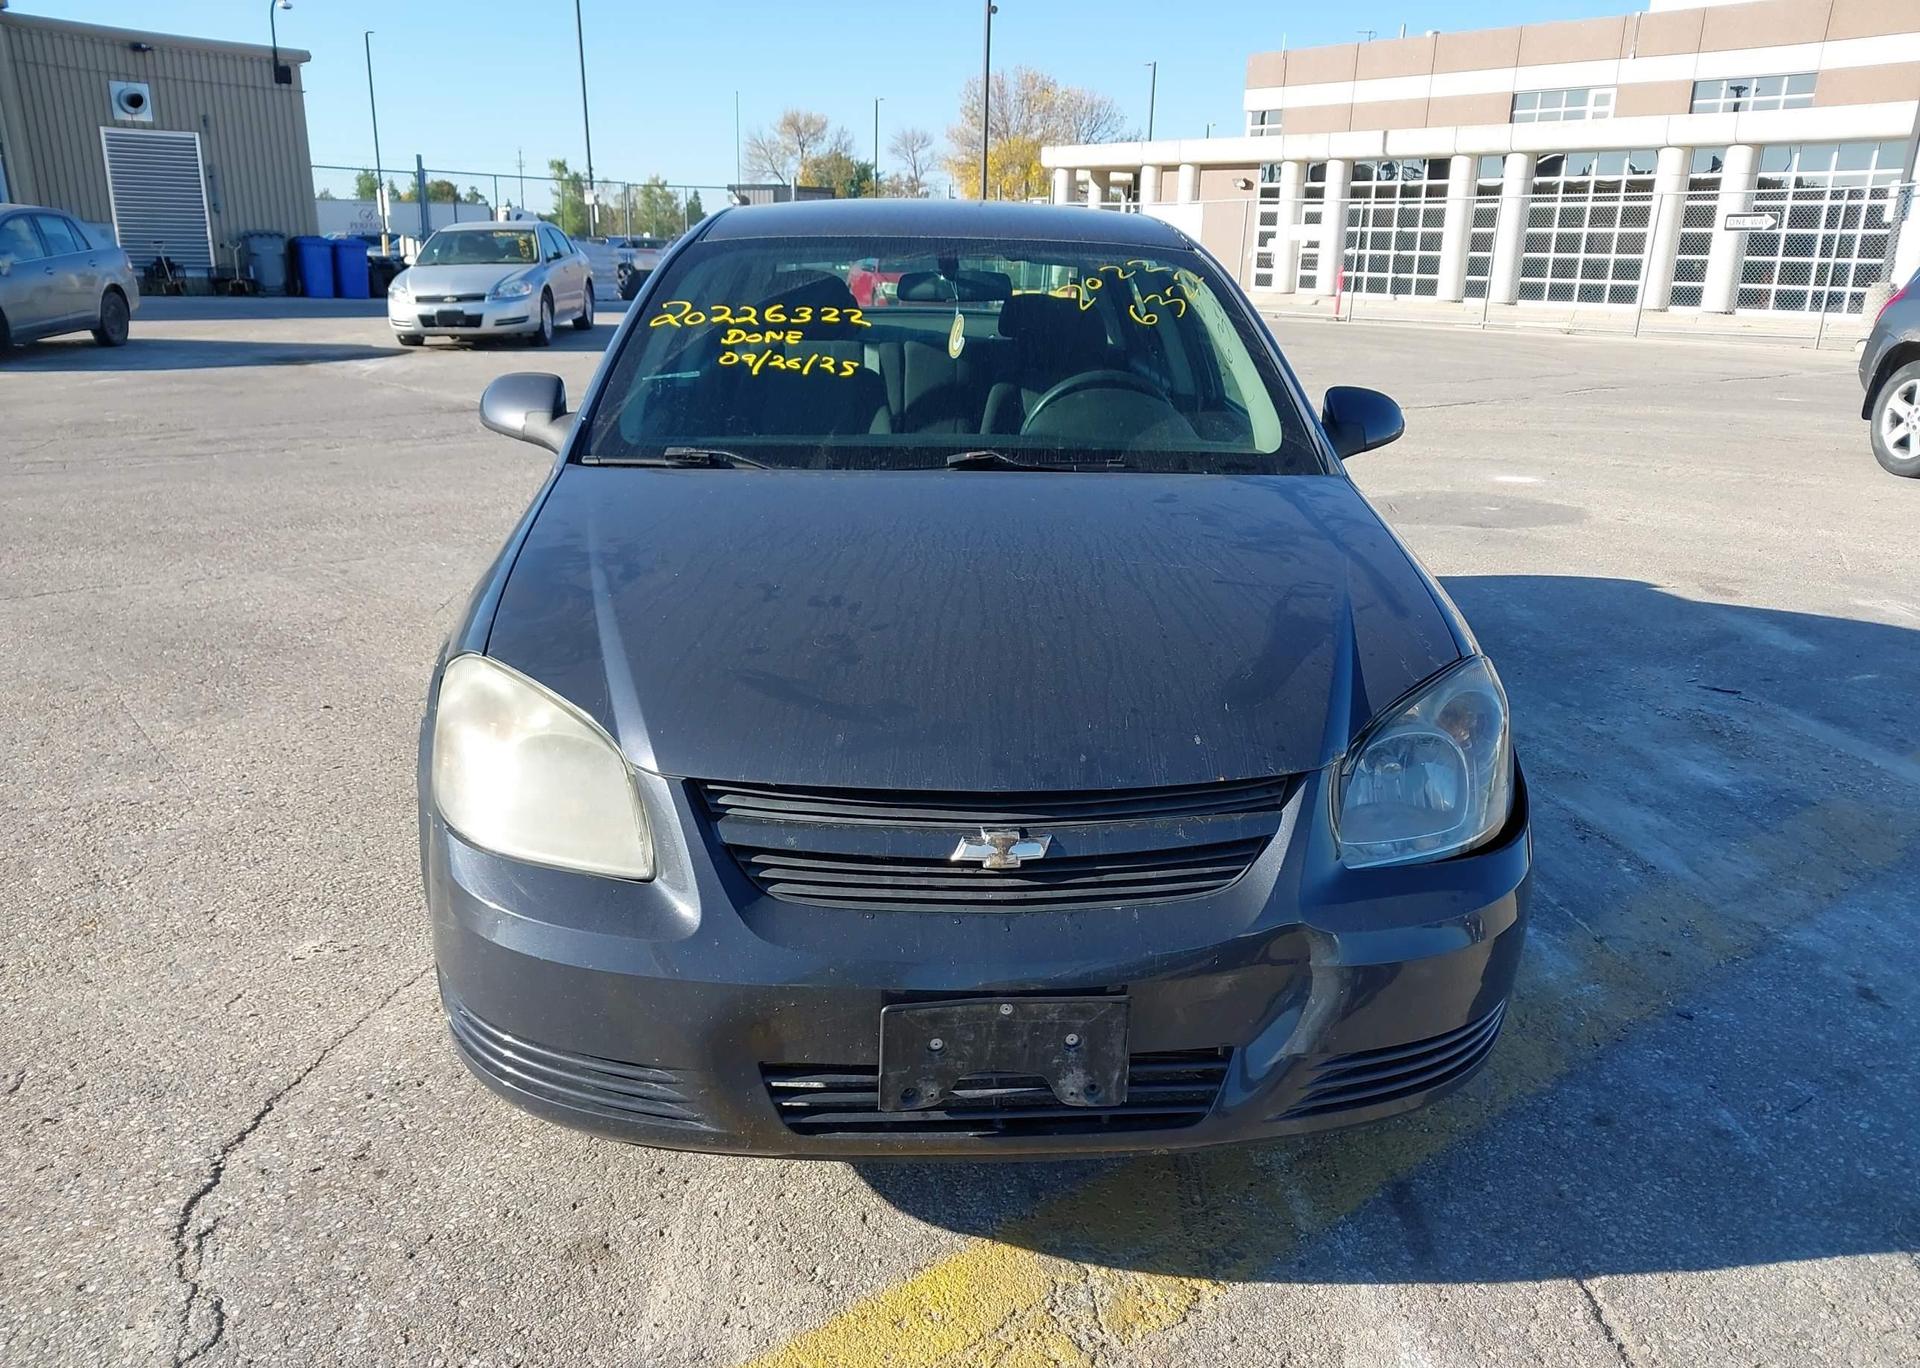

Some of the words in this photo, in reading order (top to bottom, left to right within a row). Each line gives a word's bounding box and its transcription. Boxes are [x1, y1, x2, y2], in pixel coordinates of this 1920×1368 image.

[1729, 218, 1746, 226] ONE
[1750, 217, 1770, 225] WAY
[649, 300, 872, 328] 20226322
[720, 328, 804, 345] DONE
[718, 349, 860, 377] 09/26/25
